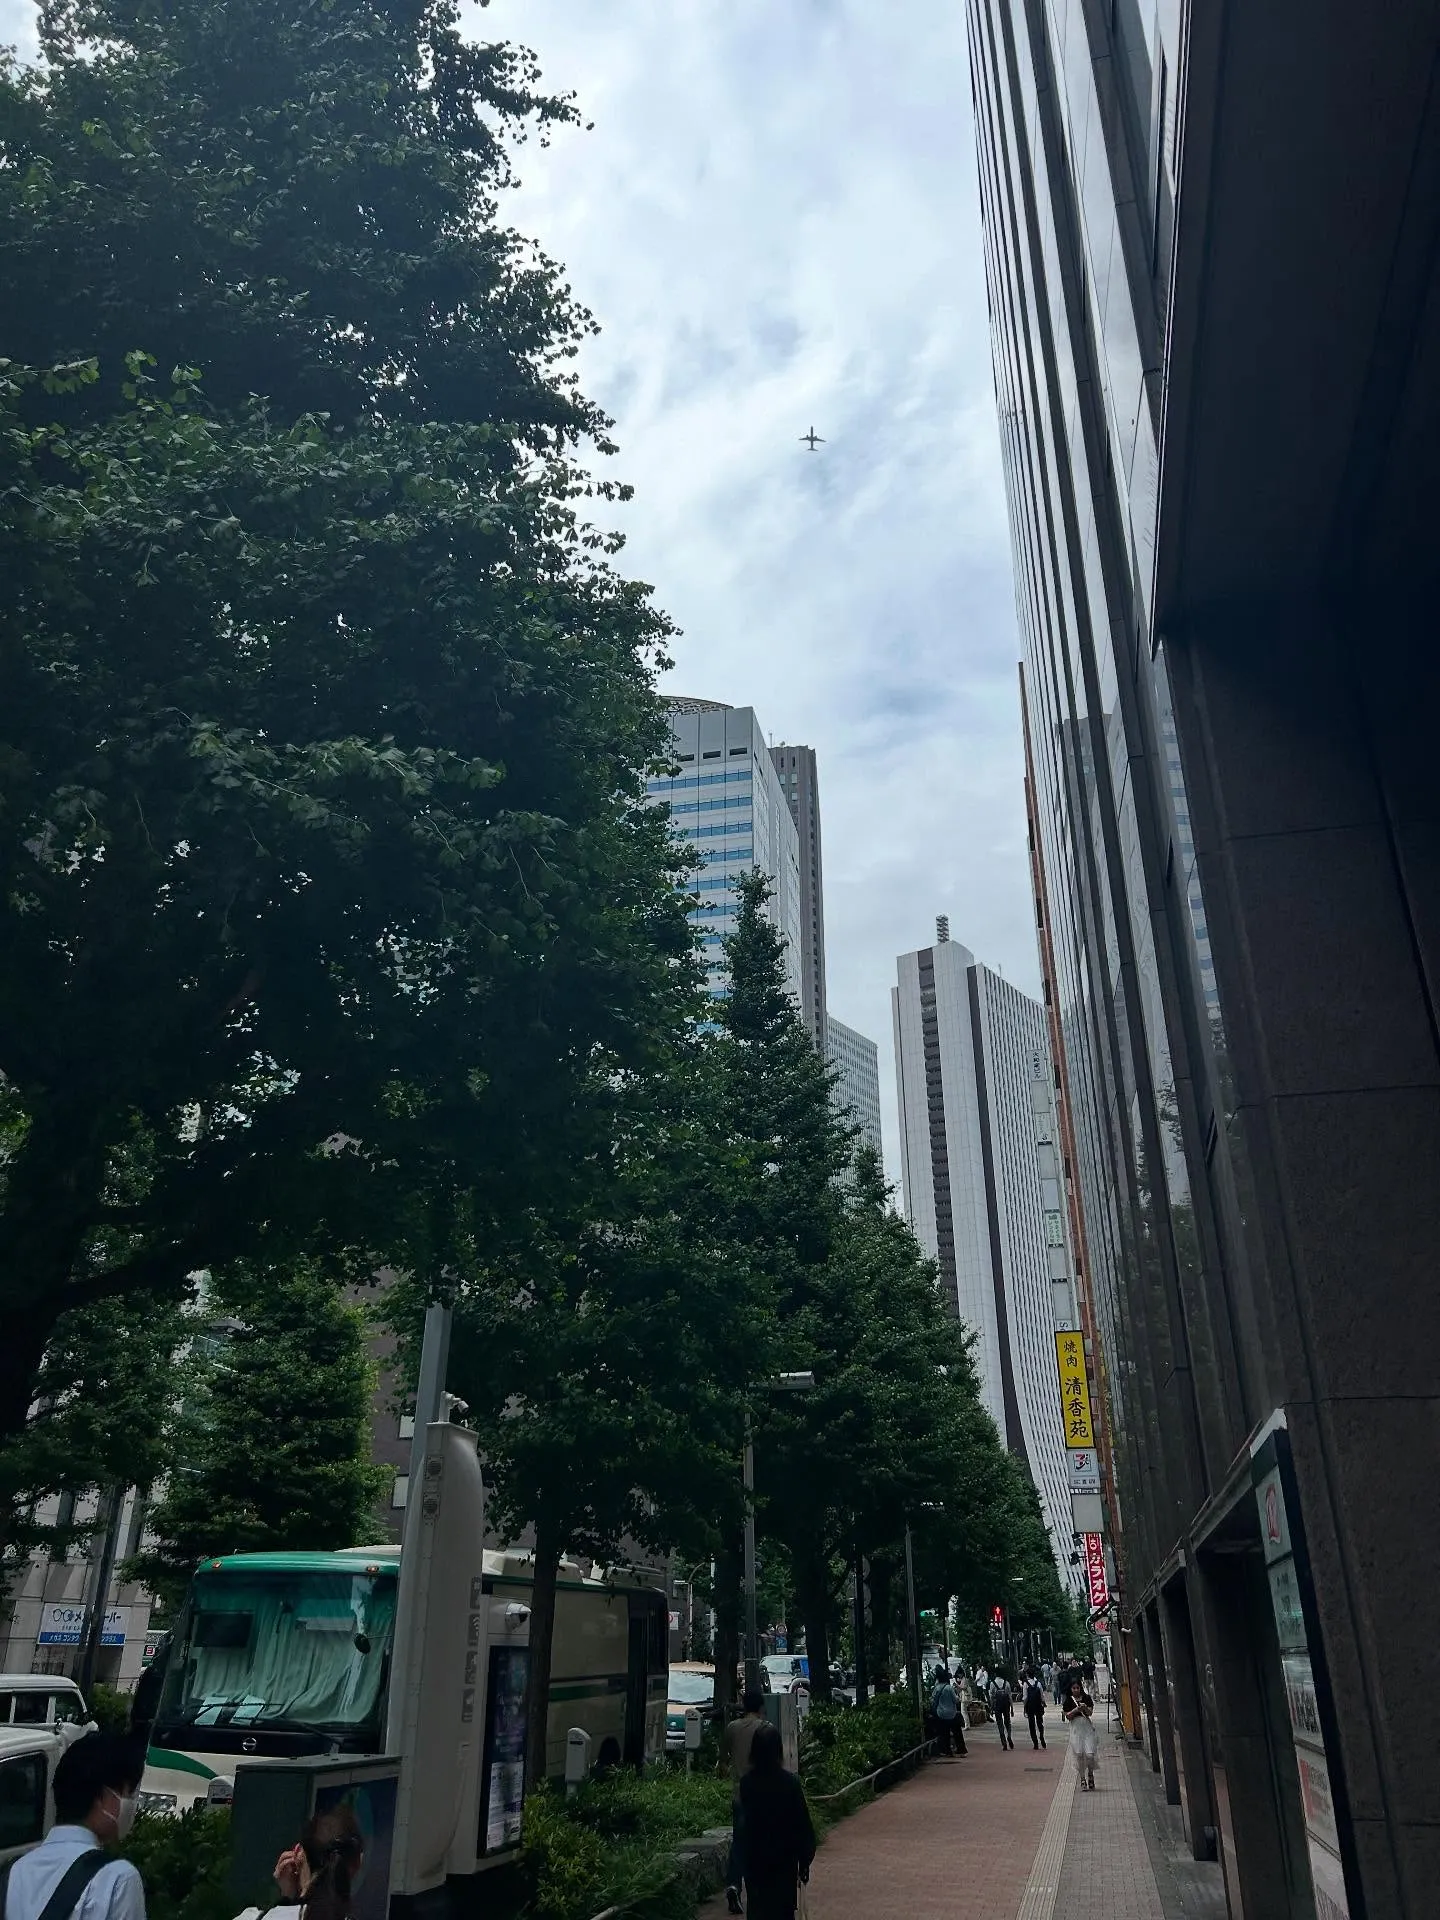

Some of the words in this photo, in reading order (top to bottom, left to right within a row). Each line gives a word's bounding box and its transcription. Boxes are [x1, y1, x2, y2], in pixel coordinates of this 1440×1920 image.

[1063, 1340, 1078, 1368] 焼肉
[1065, 1376, 1089, 1439] 清香苑
[1089, 1552, 1106, 1603] カラオケ
